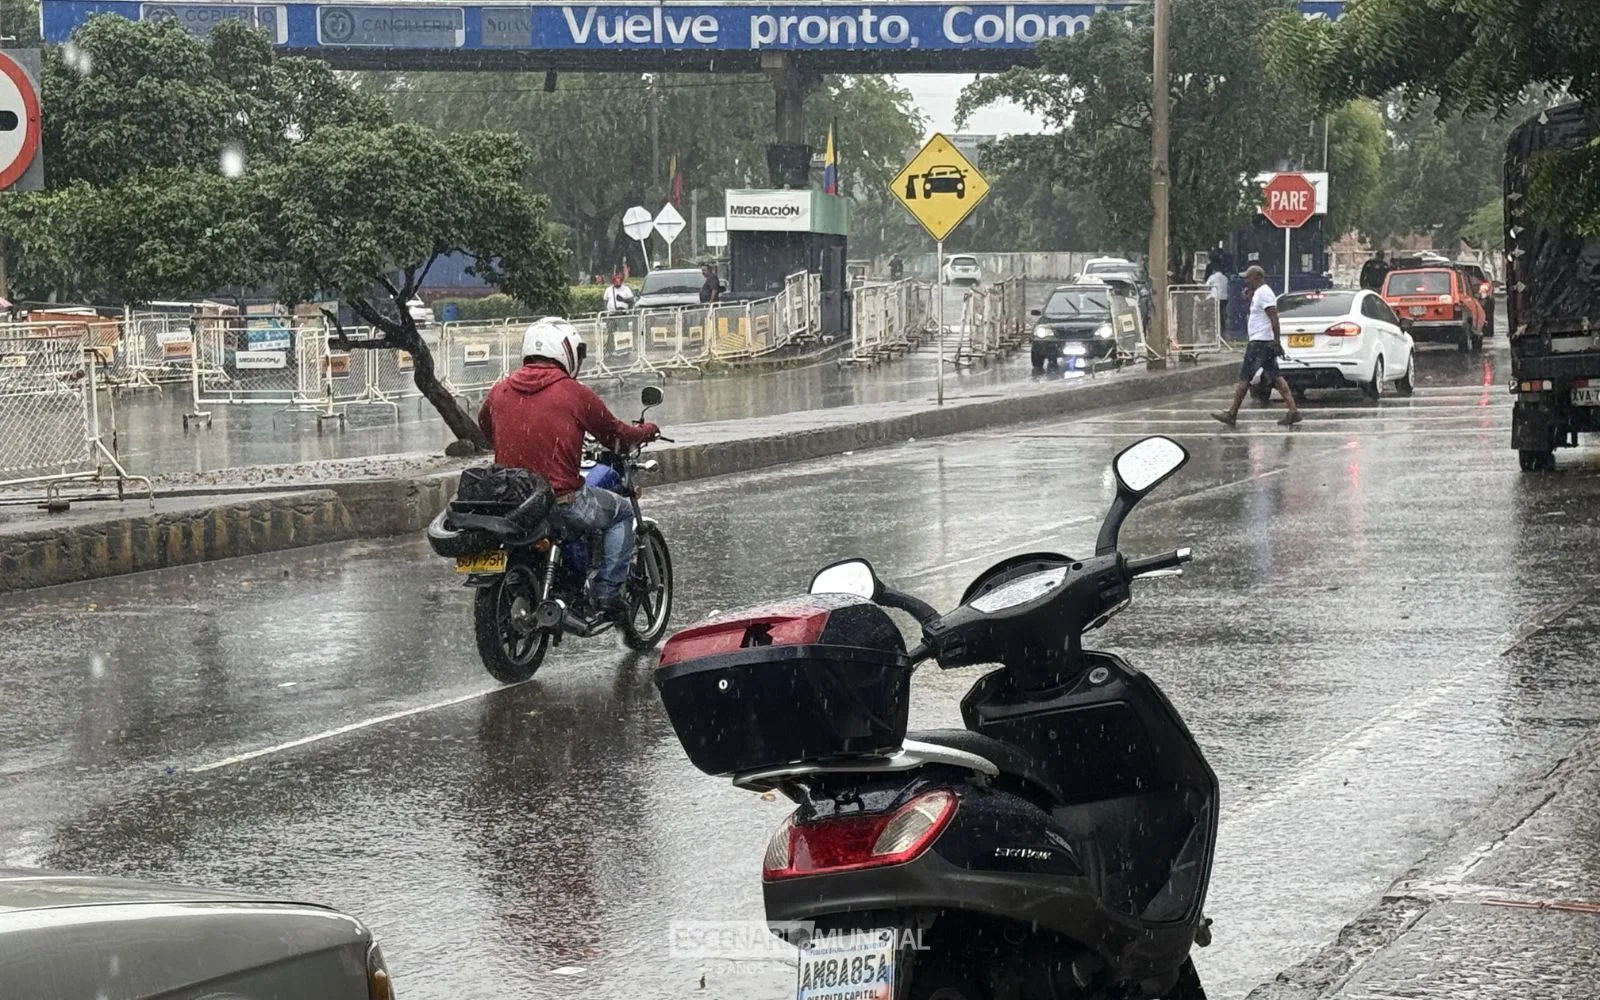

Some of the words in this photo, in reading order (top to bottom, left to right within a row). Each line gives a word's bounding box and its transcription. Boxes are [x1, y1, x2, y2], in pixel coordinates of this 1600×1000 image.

[561, 6, 719, 44] Vuelve
[751, 8, 919, 49] pronto,
[942, 6, 1100, 44] Colom
[730, 204, 800, 216] MIGRACIÓN
[1270, 190, 1309, 211] PARE
